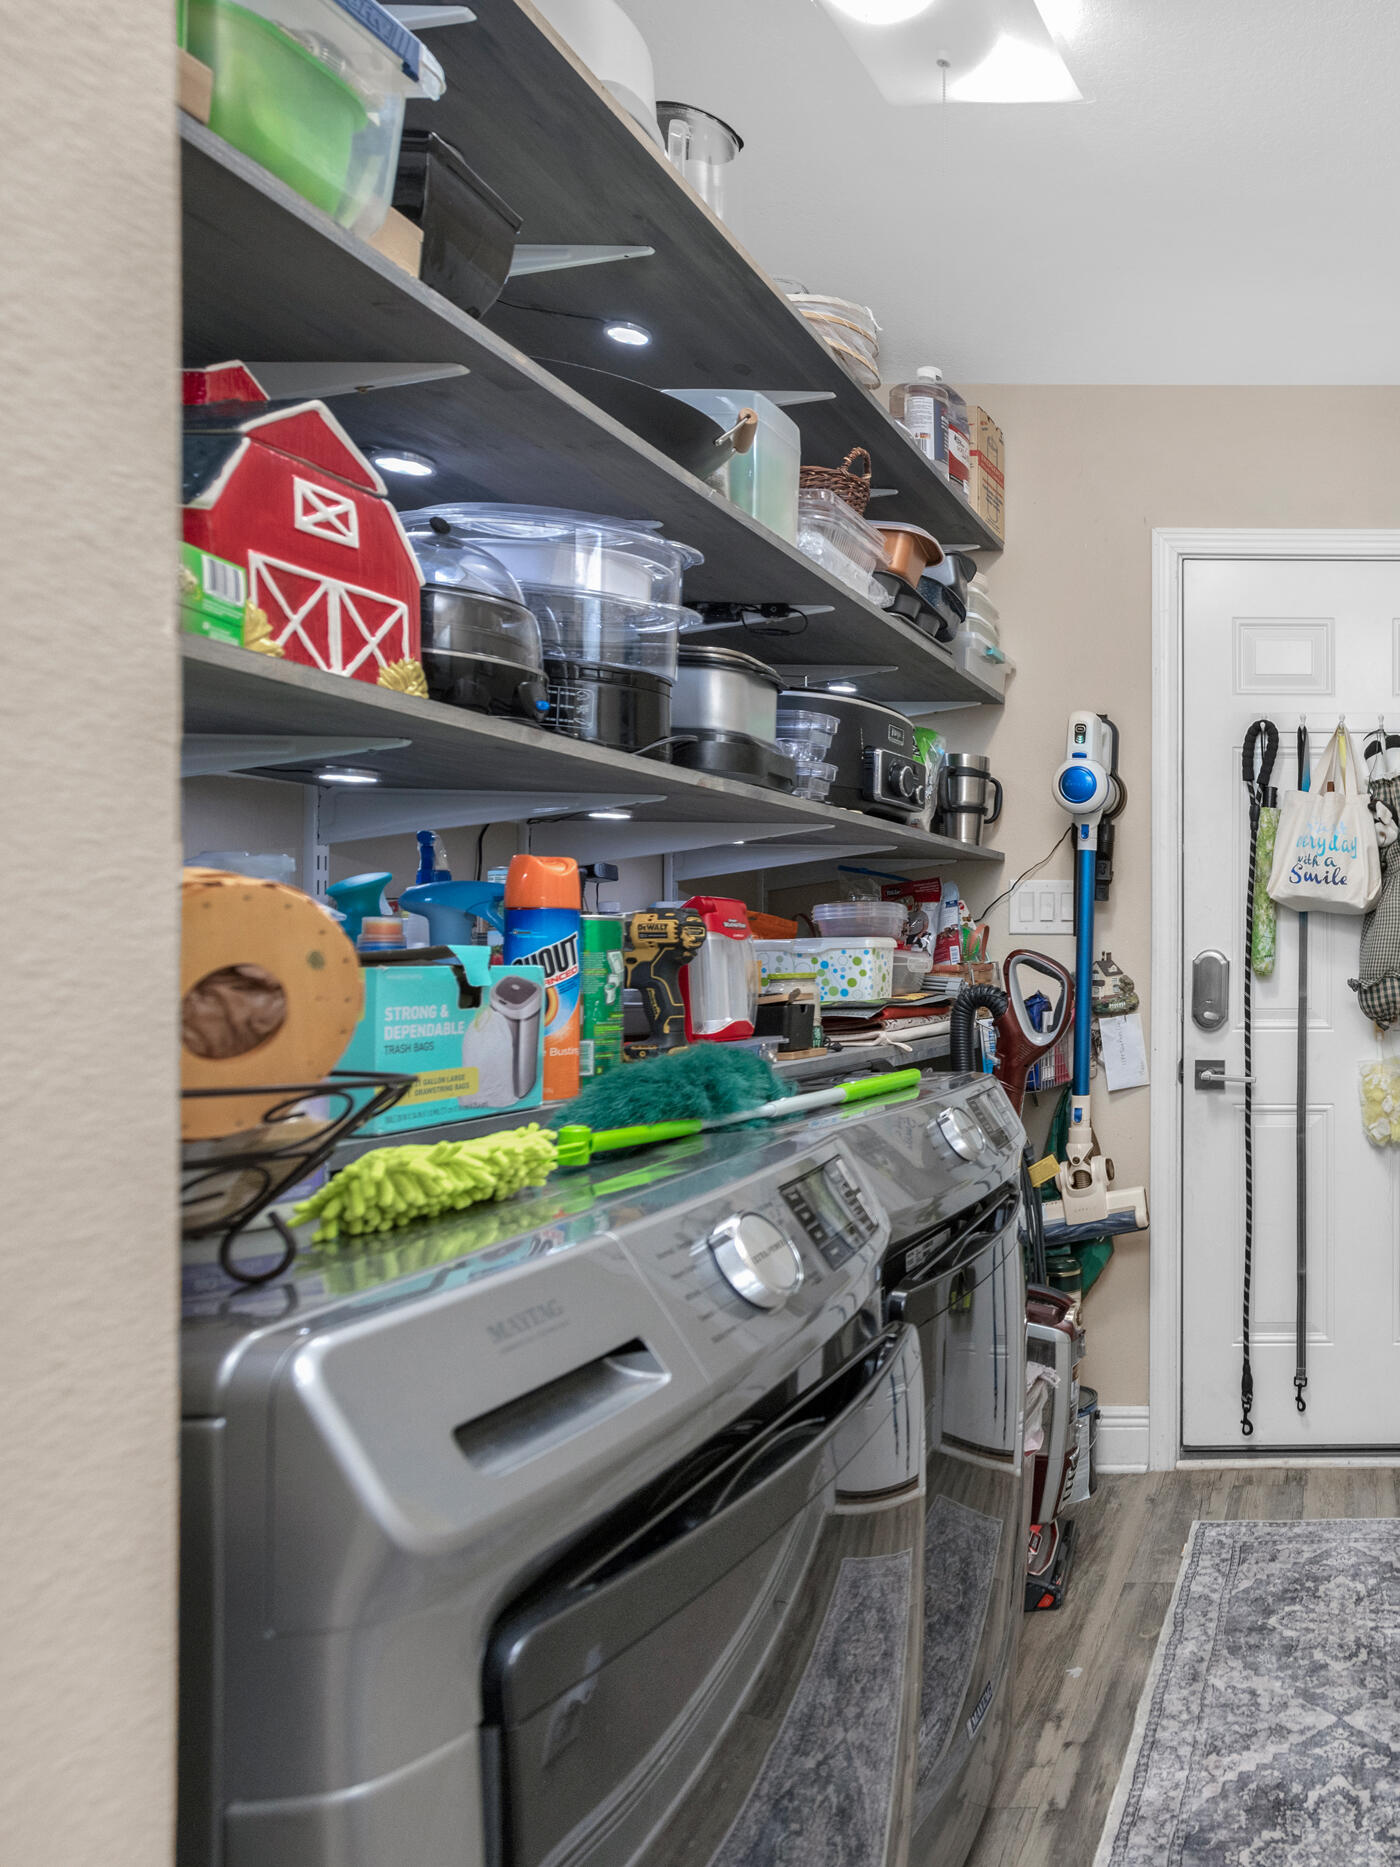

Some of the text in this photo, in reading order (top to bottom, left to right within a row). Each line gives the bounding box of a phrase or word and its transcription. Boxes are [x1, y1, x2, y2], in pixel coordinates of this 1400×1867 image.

[1324, 857, 1337, 867] a
[1289, 863, 1348, 885] Smile
[511, 931, 578, 978] OUT
[385, 1004, 449, 1021] STRONG &
[384, 1021, 465, 1041] DEPENDABLE
[384, 1041, 435, 1055] TRASH BAGS
